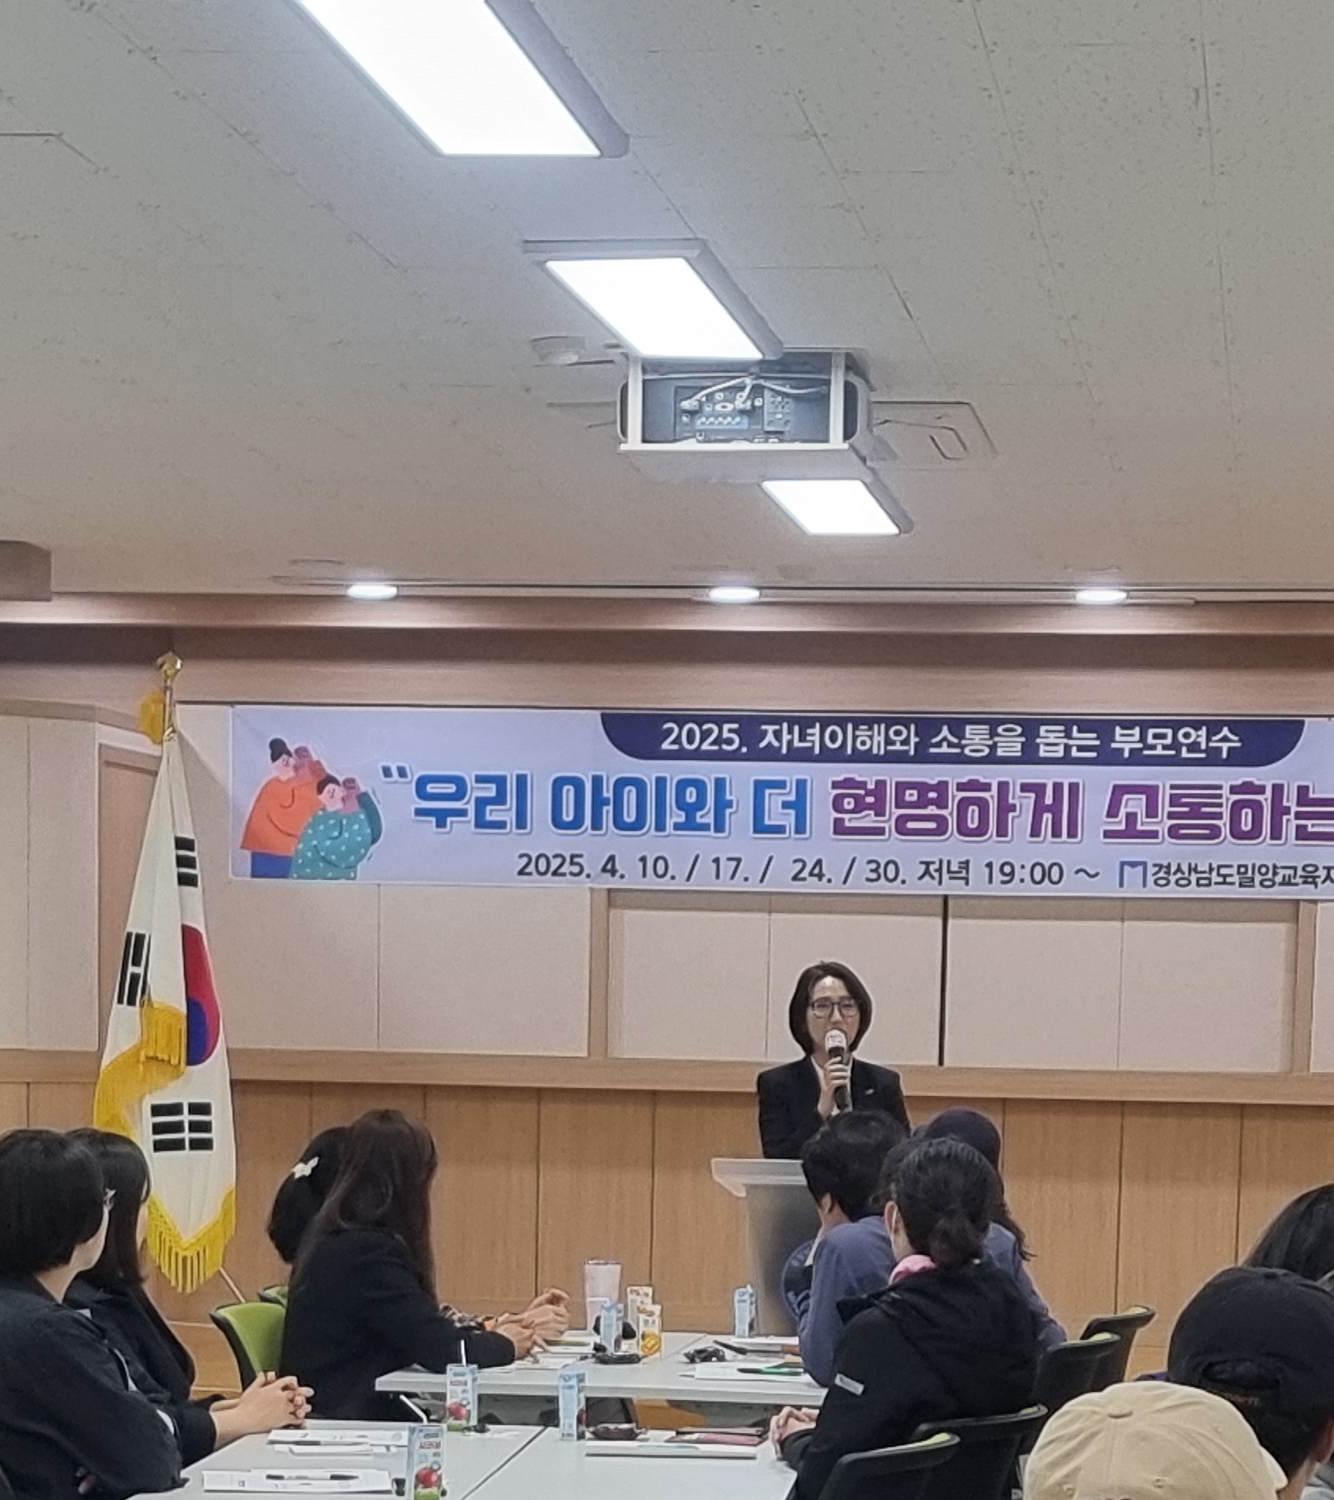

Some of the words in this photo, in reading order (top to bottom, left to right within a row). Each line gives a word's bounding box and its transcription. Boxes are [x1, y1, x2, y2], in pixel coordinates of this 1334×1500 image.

[661, 723, 748, 753] 2025.
[759, 721, 920, 756] 자녀이해와
[929, 723, 1026, 758] 소통을
[1036, 725, 1101, 758] 돕는
[1110, 725, 1242, 760] 부모연수
[550, 773, 734, 836] 아이와
[752, 777, 809, 837] 더
[831, 776, 1081, 840] 현명하게
[516, 852, 591, 879] 2025.
[599, 854, 625, 880] 4.
[637, 855, 676, 881] 10.
[711, 856, 749, 882] 17.
[790, 857, 833, 884] 24.
[864, 859, 907, 885] 30.
[917, 858, 971, 886] 저녁
[983, 860, 1065, 886] 19:00
